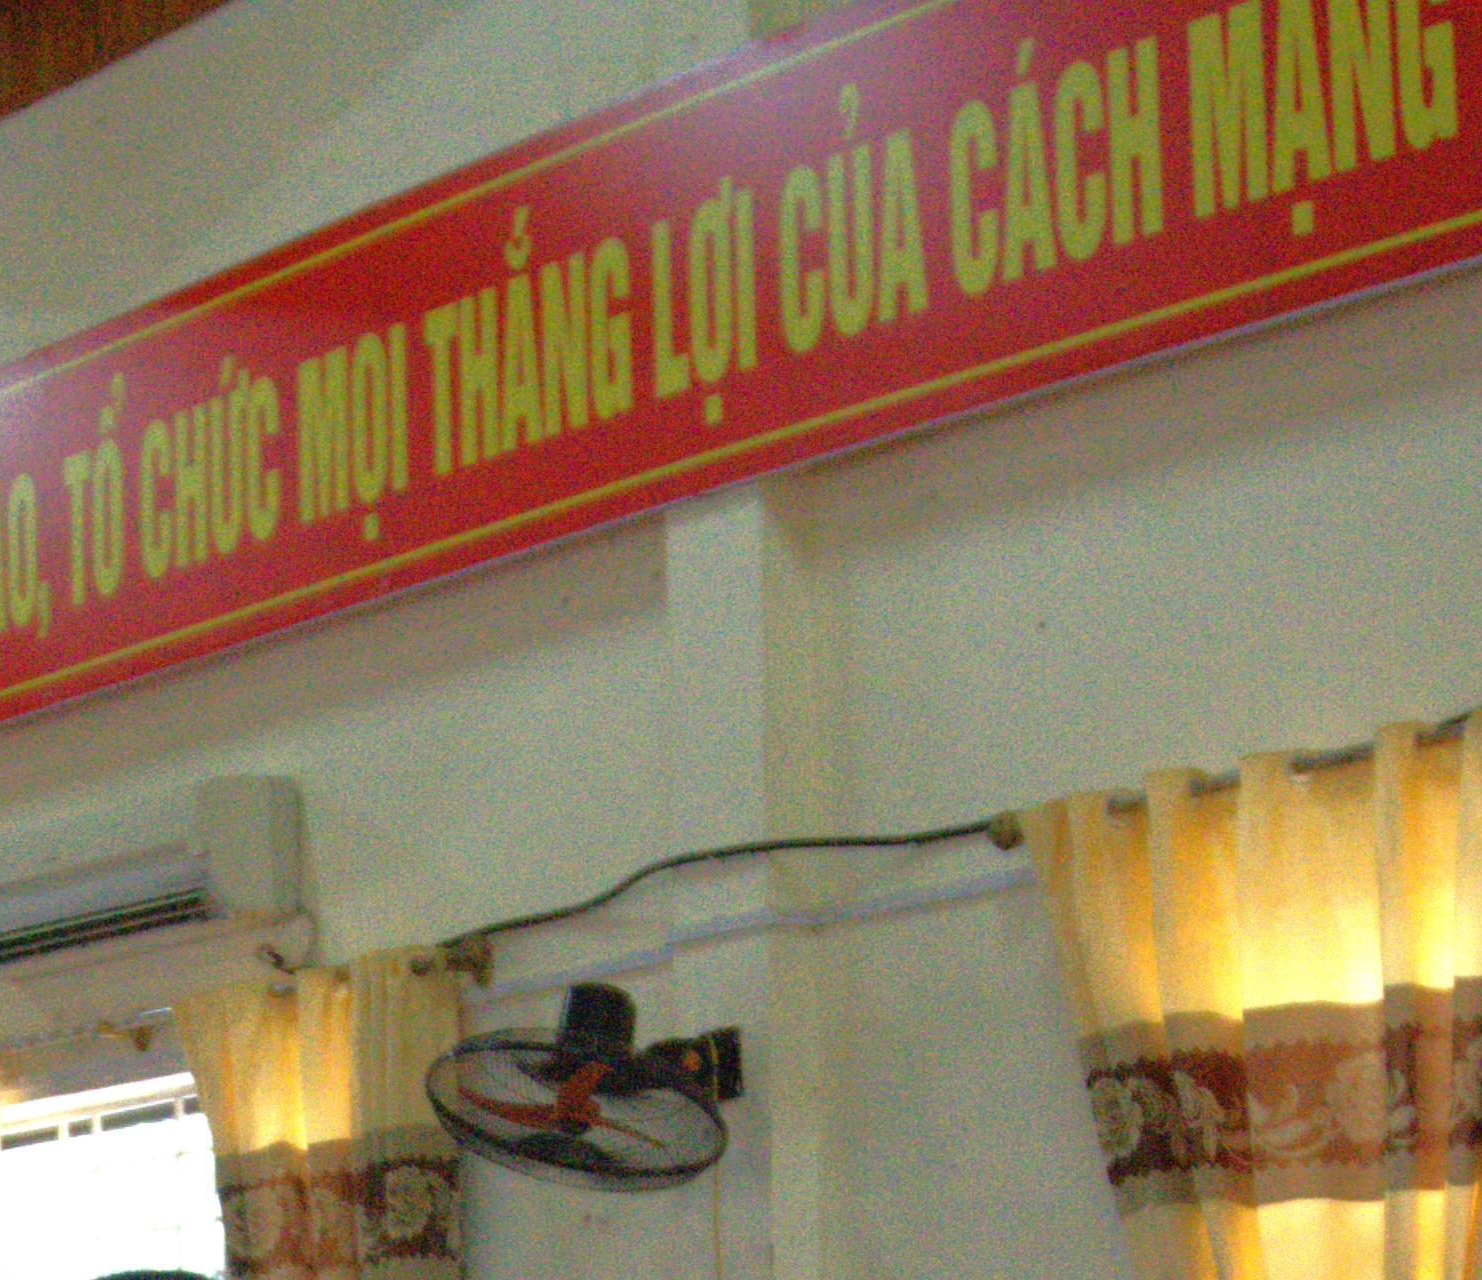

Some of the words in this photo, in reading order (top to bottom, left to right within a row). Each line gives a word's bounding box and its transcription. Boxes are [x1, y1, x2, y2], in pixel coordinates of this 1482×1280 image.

[63, 372, 125, 605] TỔ
[140, 355, 281, 579] CHỨC
[297, 322, 408, 541] MỌI
[424, 205, 633, 476] THẮNG
[650, 174, 757, 425] LỢI
[779, 82, 928, 353] CỦA
[949, 35, 1164, 296] CÁCH
[1187, 0, 1459, 236] MẠNG
